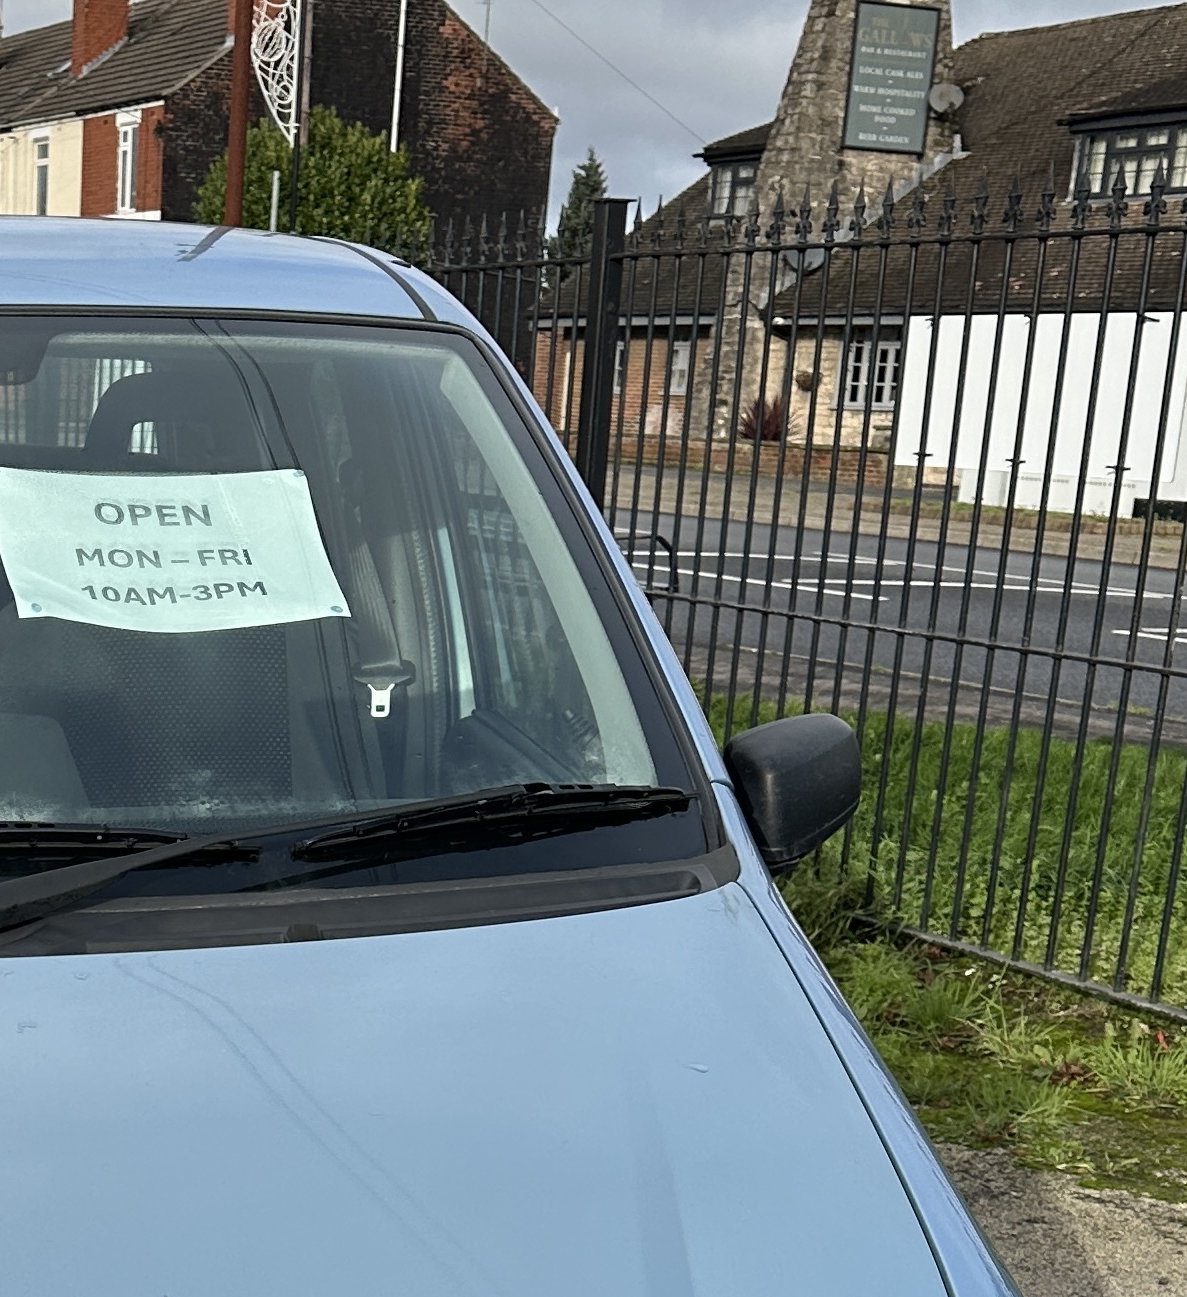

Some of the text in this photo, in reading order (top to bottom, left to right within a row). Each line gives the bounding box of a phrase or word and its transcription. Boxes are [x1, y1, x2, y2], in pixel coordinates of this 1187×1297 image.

[858, 28, 933, 49] GALLWS
[859, 66, 884, 75] LOCAL
[906, 71, 924, 79] ALES
[877, 87, 925, 99] HOSPITALITY
[859, 104, 916, 116] HOME COOKED
[874, 115, 896, 124] FOOD
[878, 134, 910, 143] GARDEN
[94, 502, 213, 527] OPEN
[75, 547, 163, 569] MON
[197, 547, 253, 567] FRI
[81, 581, 269, 606] 10AM-3PM
